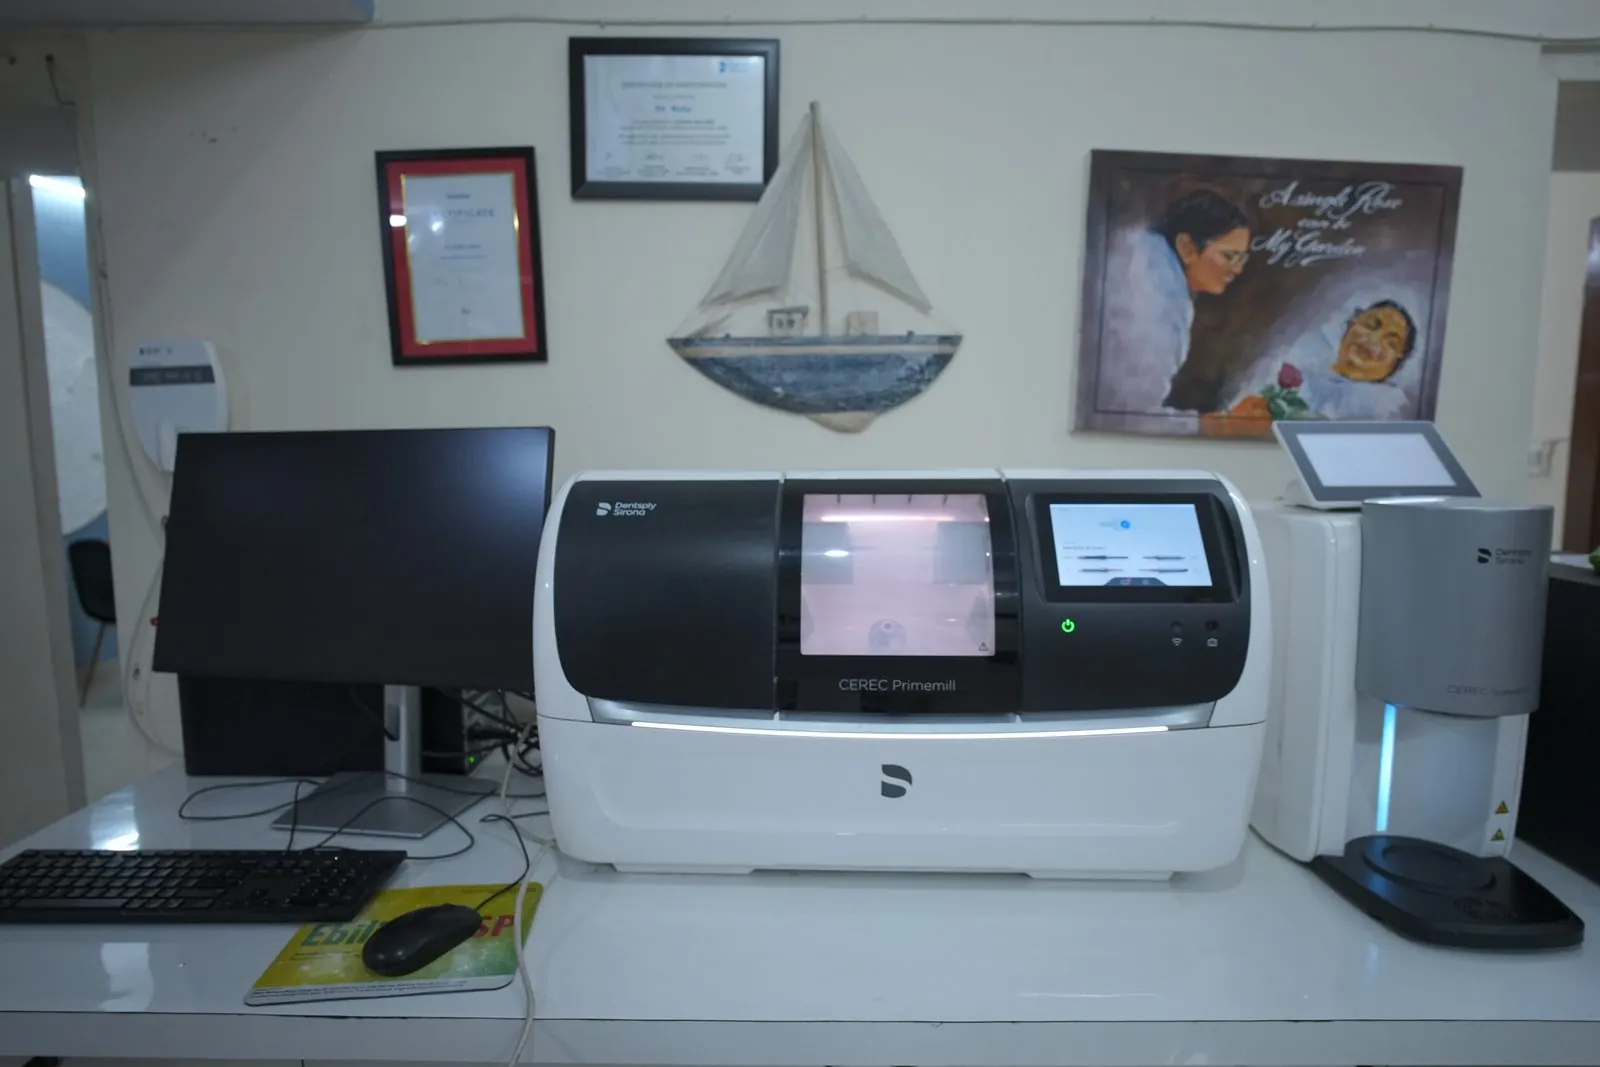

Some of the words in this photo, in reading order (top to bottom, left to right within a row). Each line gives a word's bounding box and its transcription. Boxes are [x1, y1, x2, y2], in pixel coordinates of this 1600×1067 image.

[1251, 228, 1293, 265] My
[1284, 229, 1366, 267] Garden
[614, 501, 657, 511] Dentsply
[613, 508, 646, 516] Sirona
[839, 679, 888, 691] CEREC
[892, 679, 956, 691] Primemill
